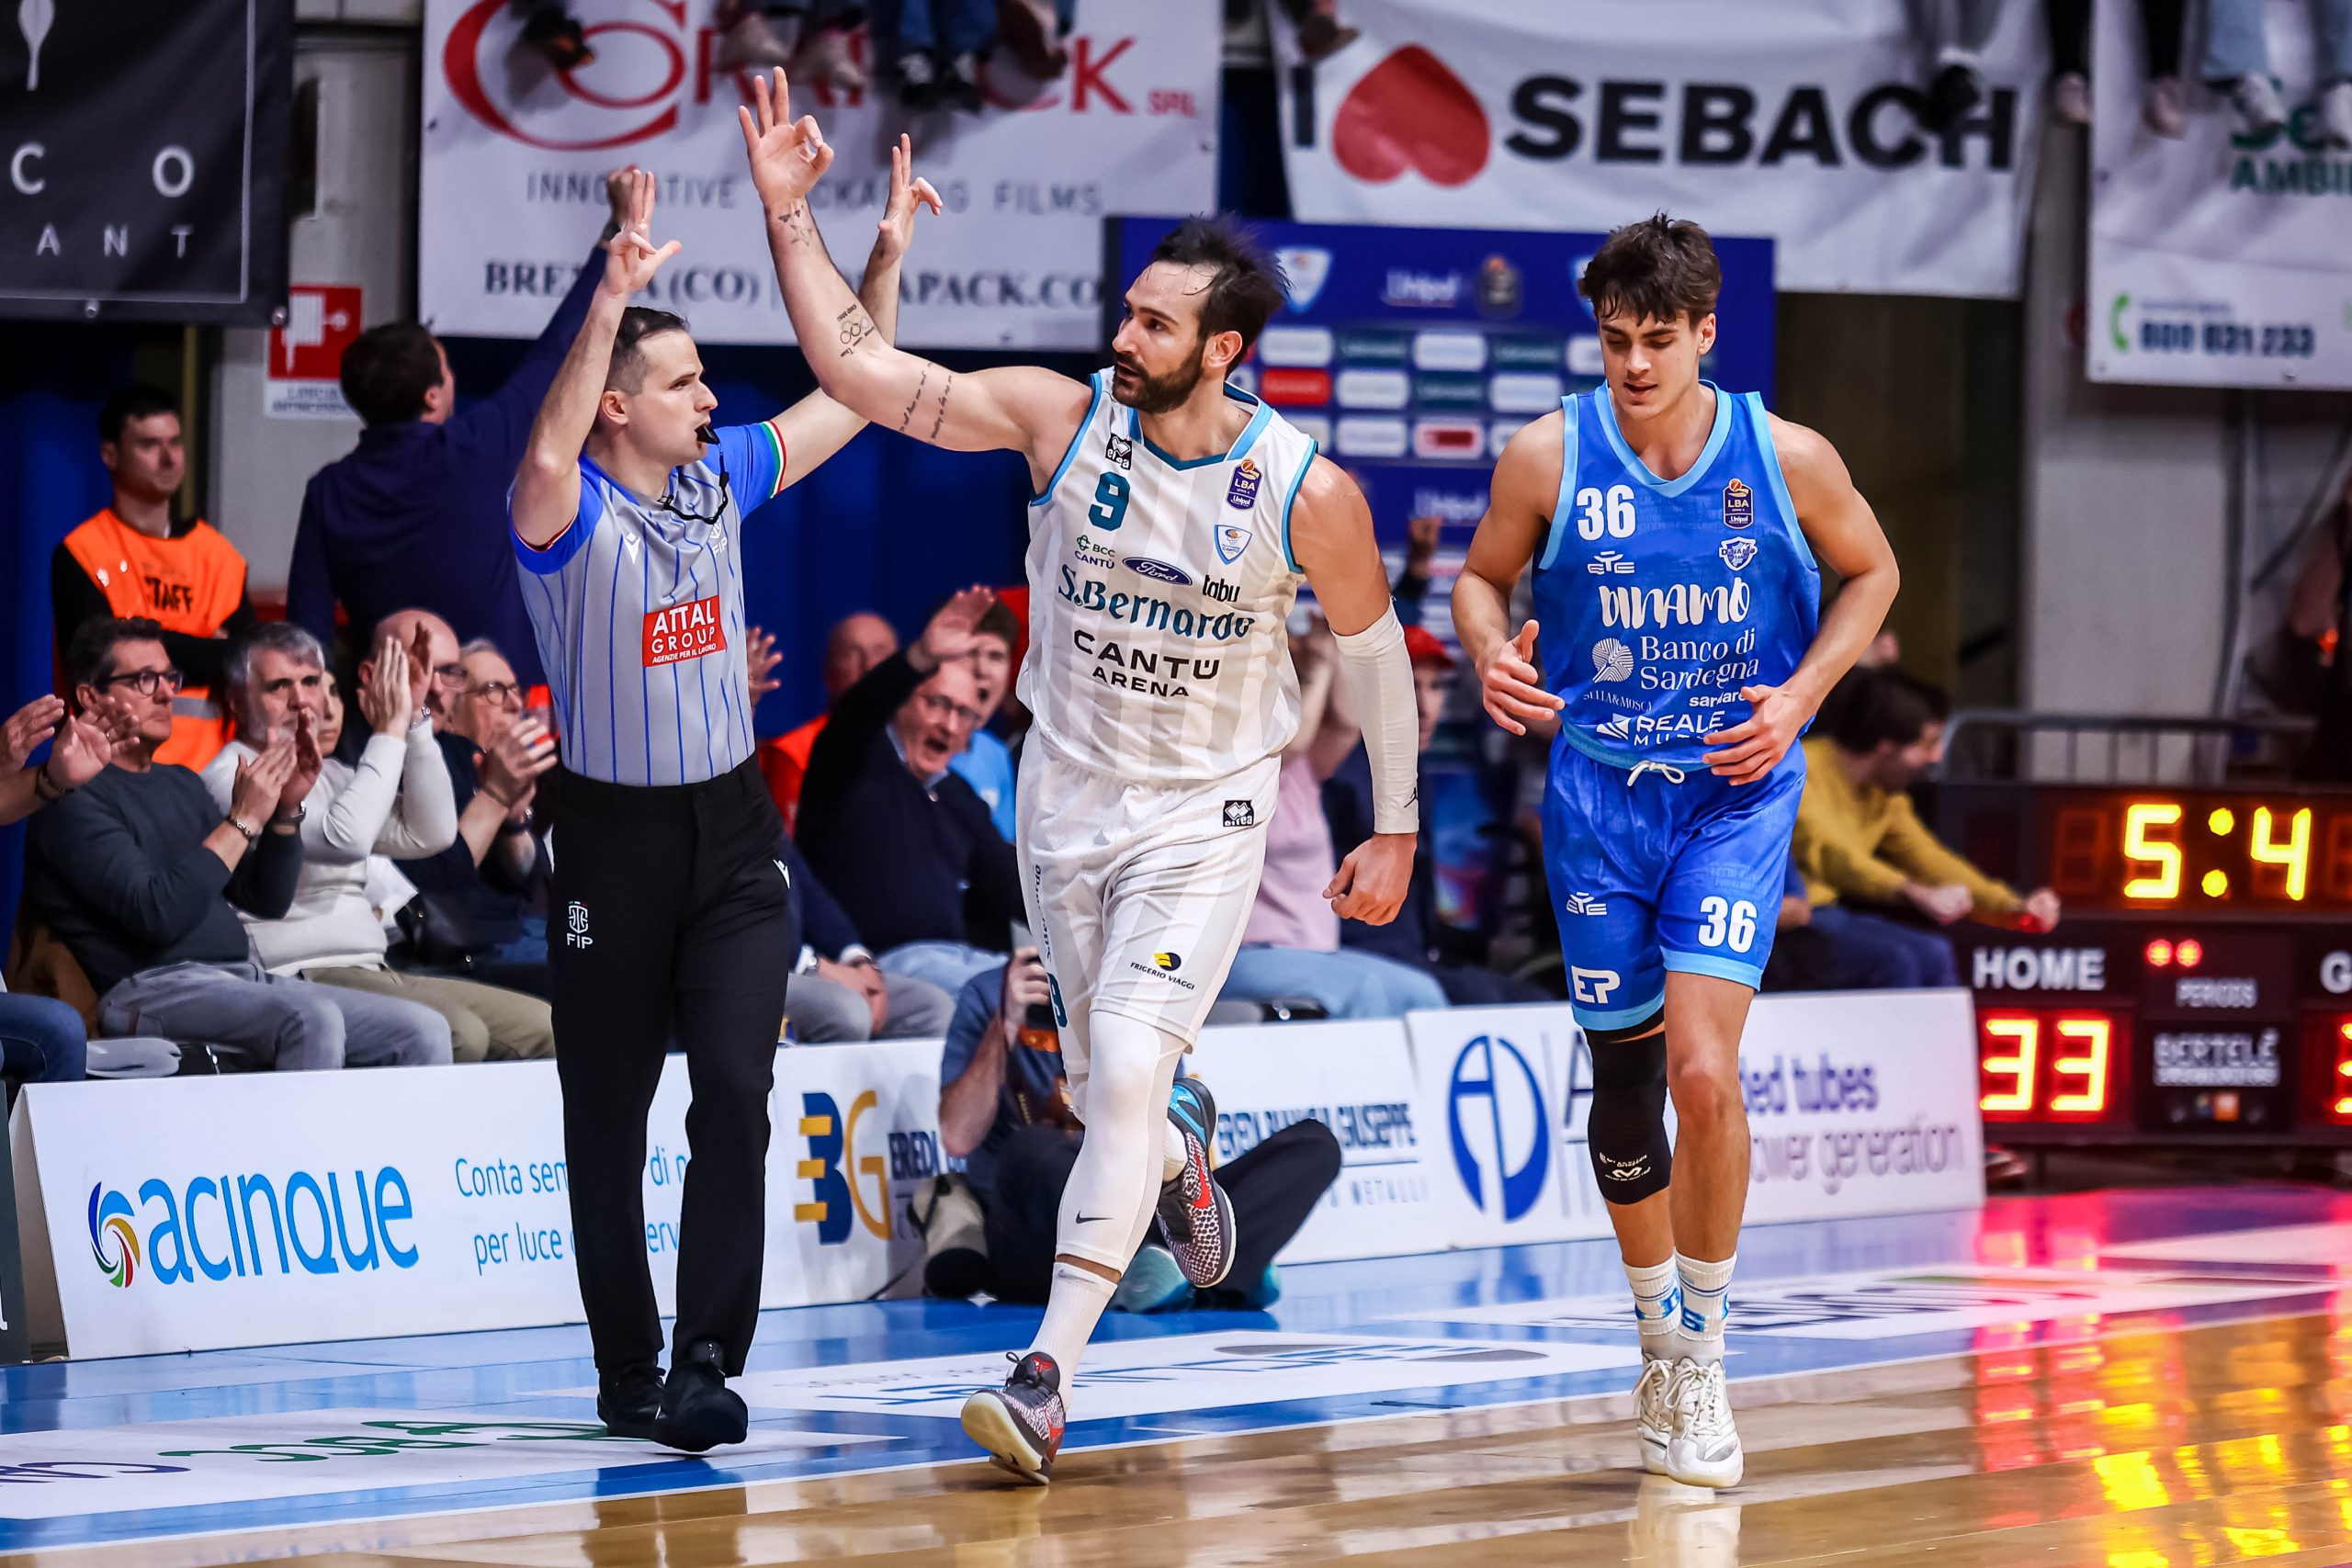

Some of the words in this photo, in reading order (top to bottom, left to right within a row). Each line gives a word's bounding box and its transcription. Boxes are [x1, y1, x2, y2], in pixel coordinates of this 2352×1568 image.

[1292, 65, 1315, 148] I
[1505, 73, 2018, 172] SEBACH
[526, 173, 737, 209] INNTIVE
[1088, 470, 1131, 532] 9
[1232, 494, 1251, 505] Unipol
[1234, 478, 1256, 491] LBA
[1576, 484, 1635, 541] 36
[1727, 499, 1750, 508] LBA
[1730, 515, 1749, 525] Unipol
[711, 536, 728, 558] FIP
[1091, 543, 1116, 558] BCC
[1136, 560, 1180, 581] Ford
[1202, 574, 1241, 603] tabu
[651, 600, 716, 637] ATTAL
[650, 626, 716, 654] GROUP
[651, 652, 678, 664] AGENZIE
[679, 649, 691, 660] PER
[691, 649, 698, 657] IL
[1640, 635, 1728, 662] Banco
[1735, 627, 1756, 656] di
[1091, 666, 1190, 698] ARENA
[1640, 657, 1759, 691] Sardegna
[1635, 710, 1725, 734] REALE
[566, 931, 594, 950] FIP
[1698, 895, 1758, 953] 36
[1129, 961, 1167, 980] FRIGERIO
[1168, 974, 1196, 991] VIAGGI
[1570, 964, 1621, 1004] EP
[1972, 946, 2107, 992] HOME
[1979, 1018, 2111, 1111] 33
[1792, 1053, 1879, 1115] tubes
[456, 1156, 522, 1198] Conta
[650, 1145, 671, 1187] di
[1749, 1134, 1814, 1184] ower
[1818, 1113, 1965, 1196] generation
[473, 1231, 510, 1276] per
[515, 1221, 563, 1262] luce
